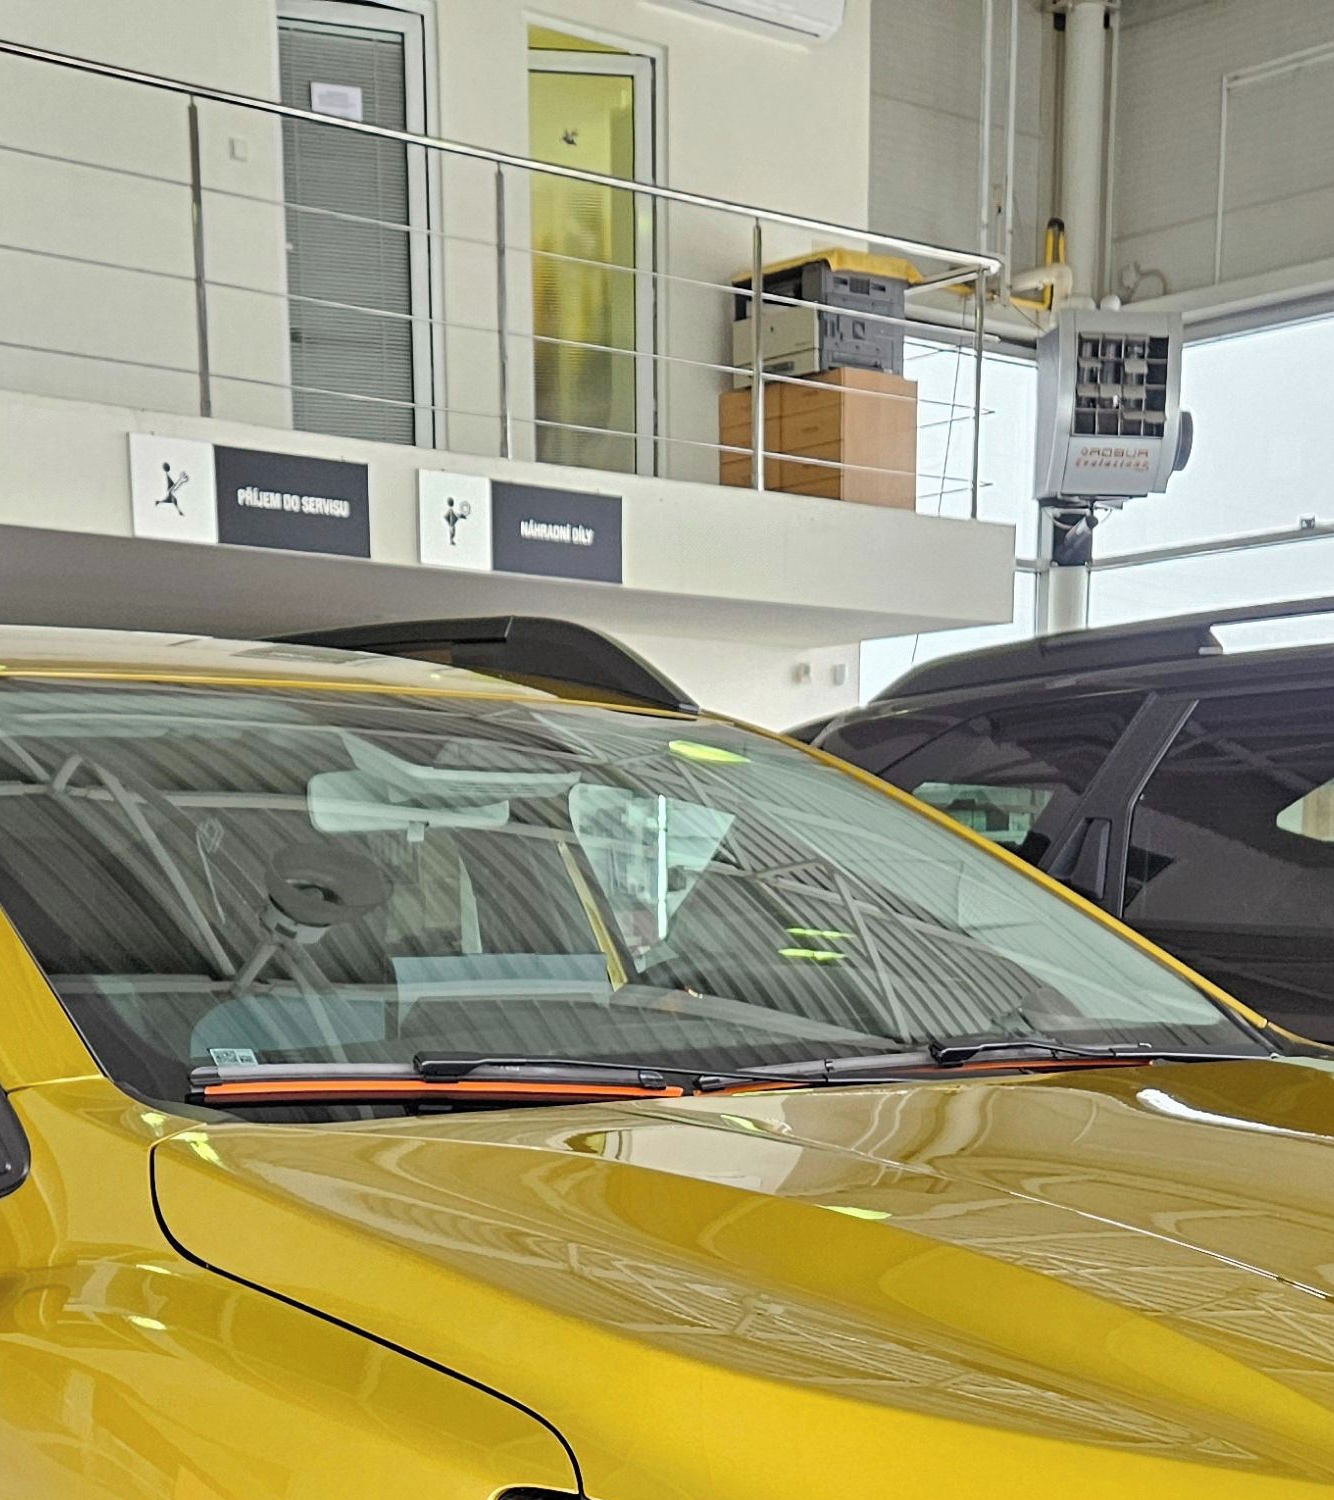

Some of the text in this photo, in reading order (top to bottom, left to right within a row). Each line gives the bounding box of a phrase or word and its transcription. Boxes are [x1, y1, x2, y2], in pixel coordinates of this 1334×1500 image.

[237, 486, 350, 518] PŘÍJEM DO SERVISU
[520, 519, 572, 544] NÁHRADNÍ
